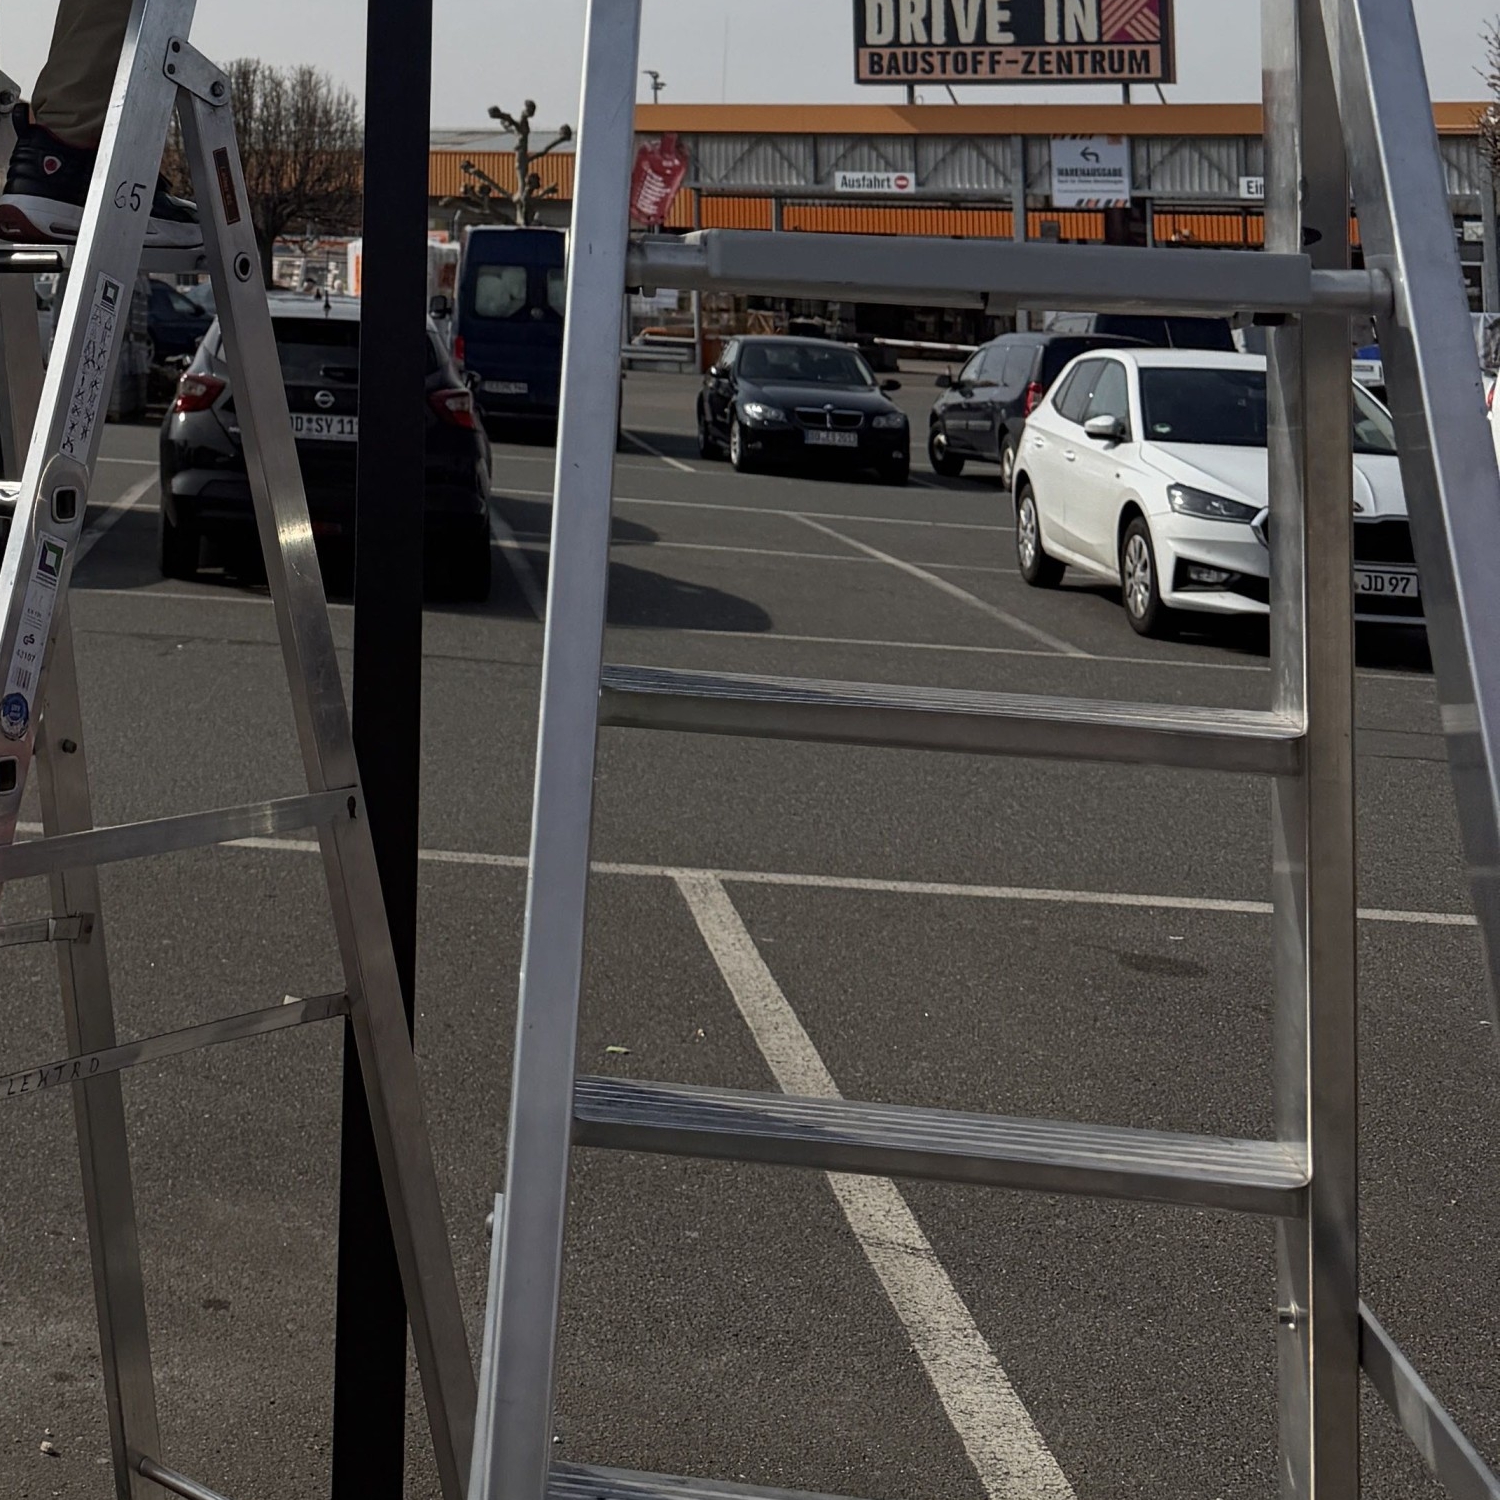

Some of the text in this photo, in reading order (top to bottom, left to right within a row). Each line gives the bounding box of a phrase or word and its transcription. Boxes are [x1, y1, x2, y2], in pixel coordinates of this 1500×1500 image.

[868, 49, 1151, 76] BAUSTOFF-ZENTRUM
[841, 174, 891, 189] Ausfahrt
[114, 181, 147, 212] 65
[315, 417, 333, 434] SY
[337, 418, 358, 435] 11
[1361, 574, 1411, 594] JD 97
